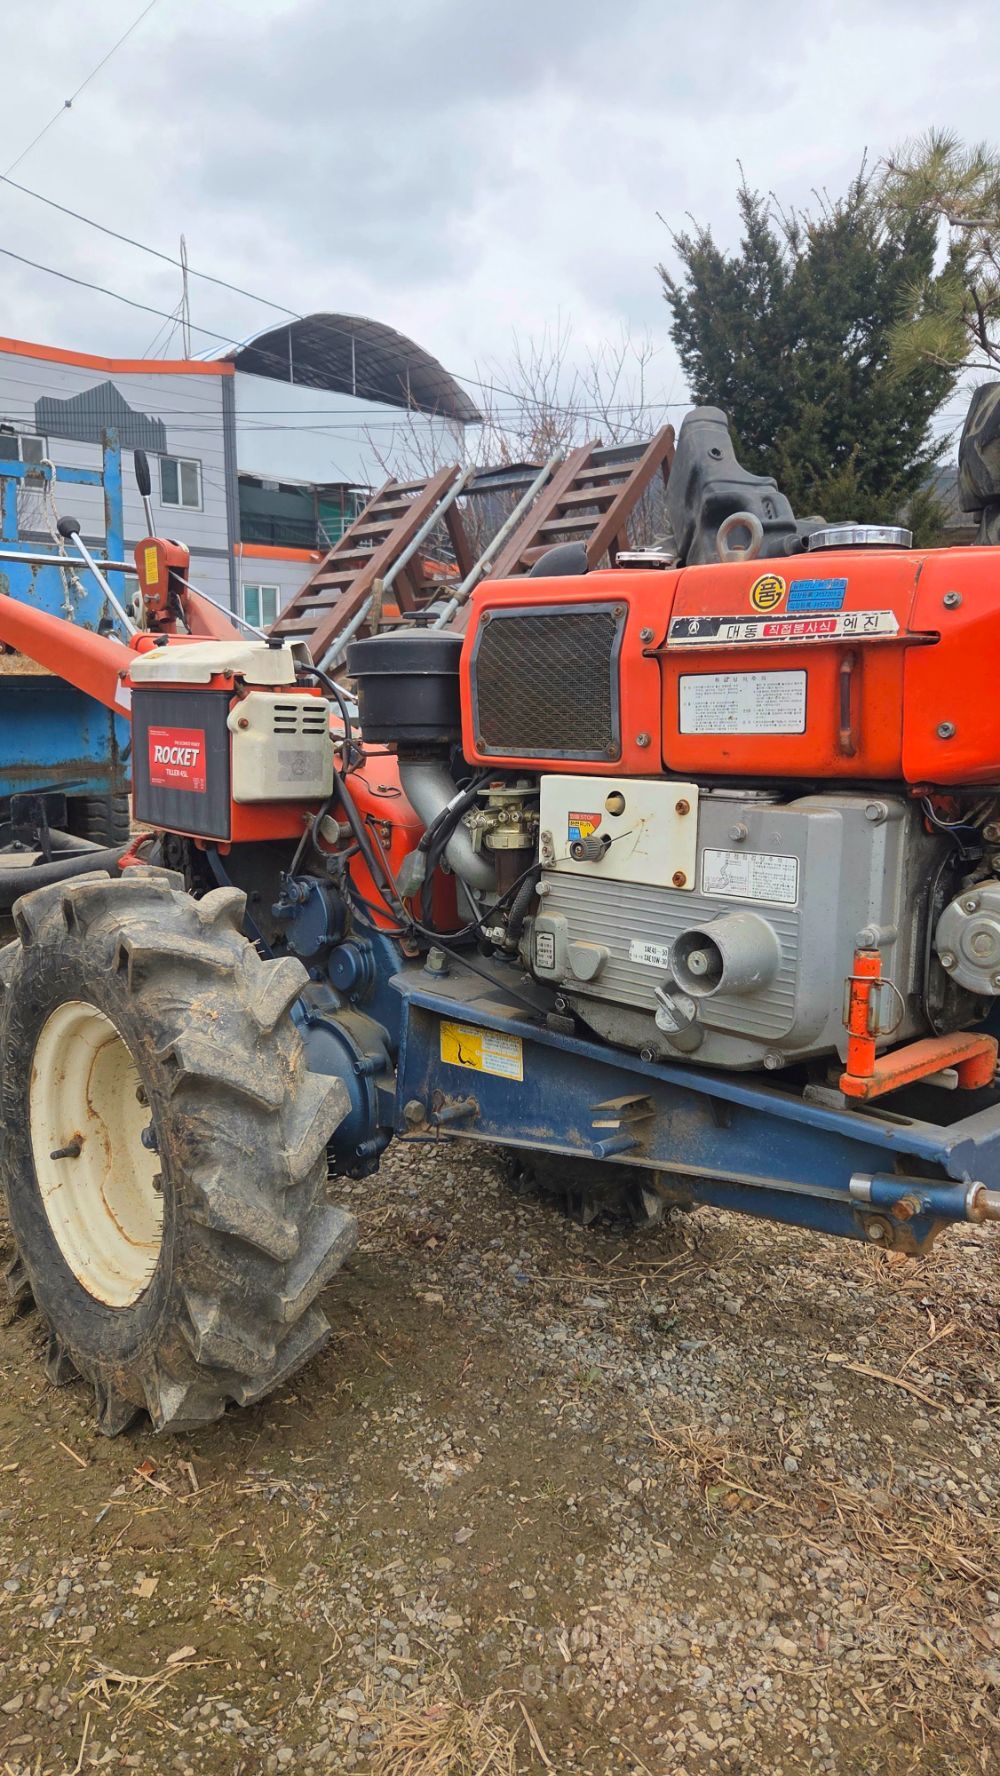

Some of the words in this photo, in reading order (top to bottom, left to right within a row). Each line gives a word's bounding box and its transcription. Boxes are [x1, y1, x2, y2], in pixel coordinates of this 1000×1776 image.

[726, 624, 758, 639] 대동
[768, 622, 833, 635] 직접분사식
[154, 745, 200, 767] ROCKET
